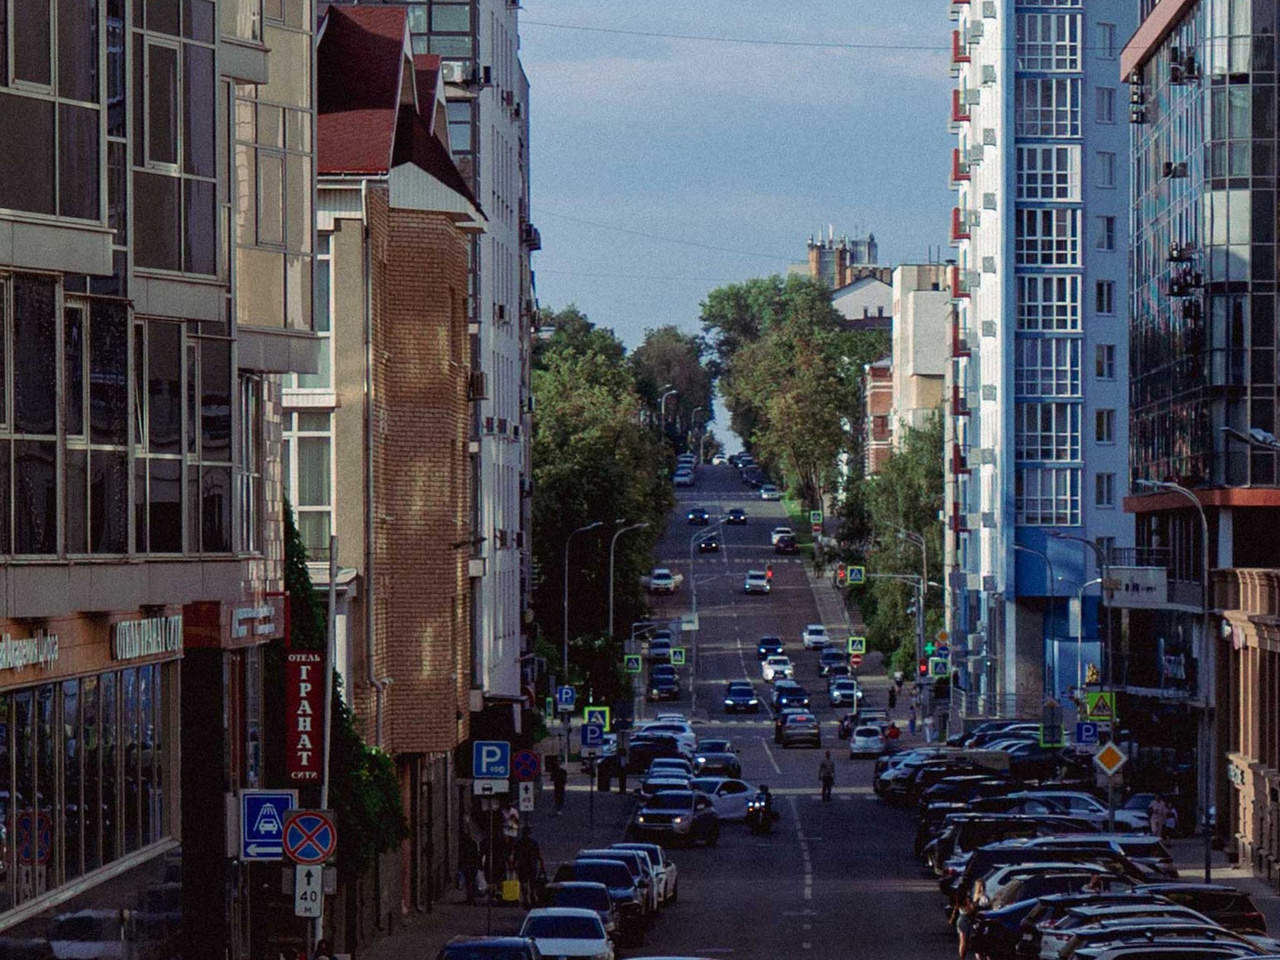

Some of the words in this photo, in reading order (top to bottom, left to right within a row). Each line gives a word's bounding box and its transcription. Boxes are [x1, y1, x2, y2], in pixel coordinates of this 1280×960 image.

[288, 654, 321, 662] ОТЕЛЬ
[296, 665, 313, 766] ГРАНАТ
[291, 771, 317, 779] СИТИ
[300, 891, 317, 902] 40
